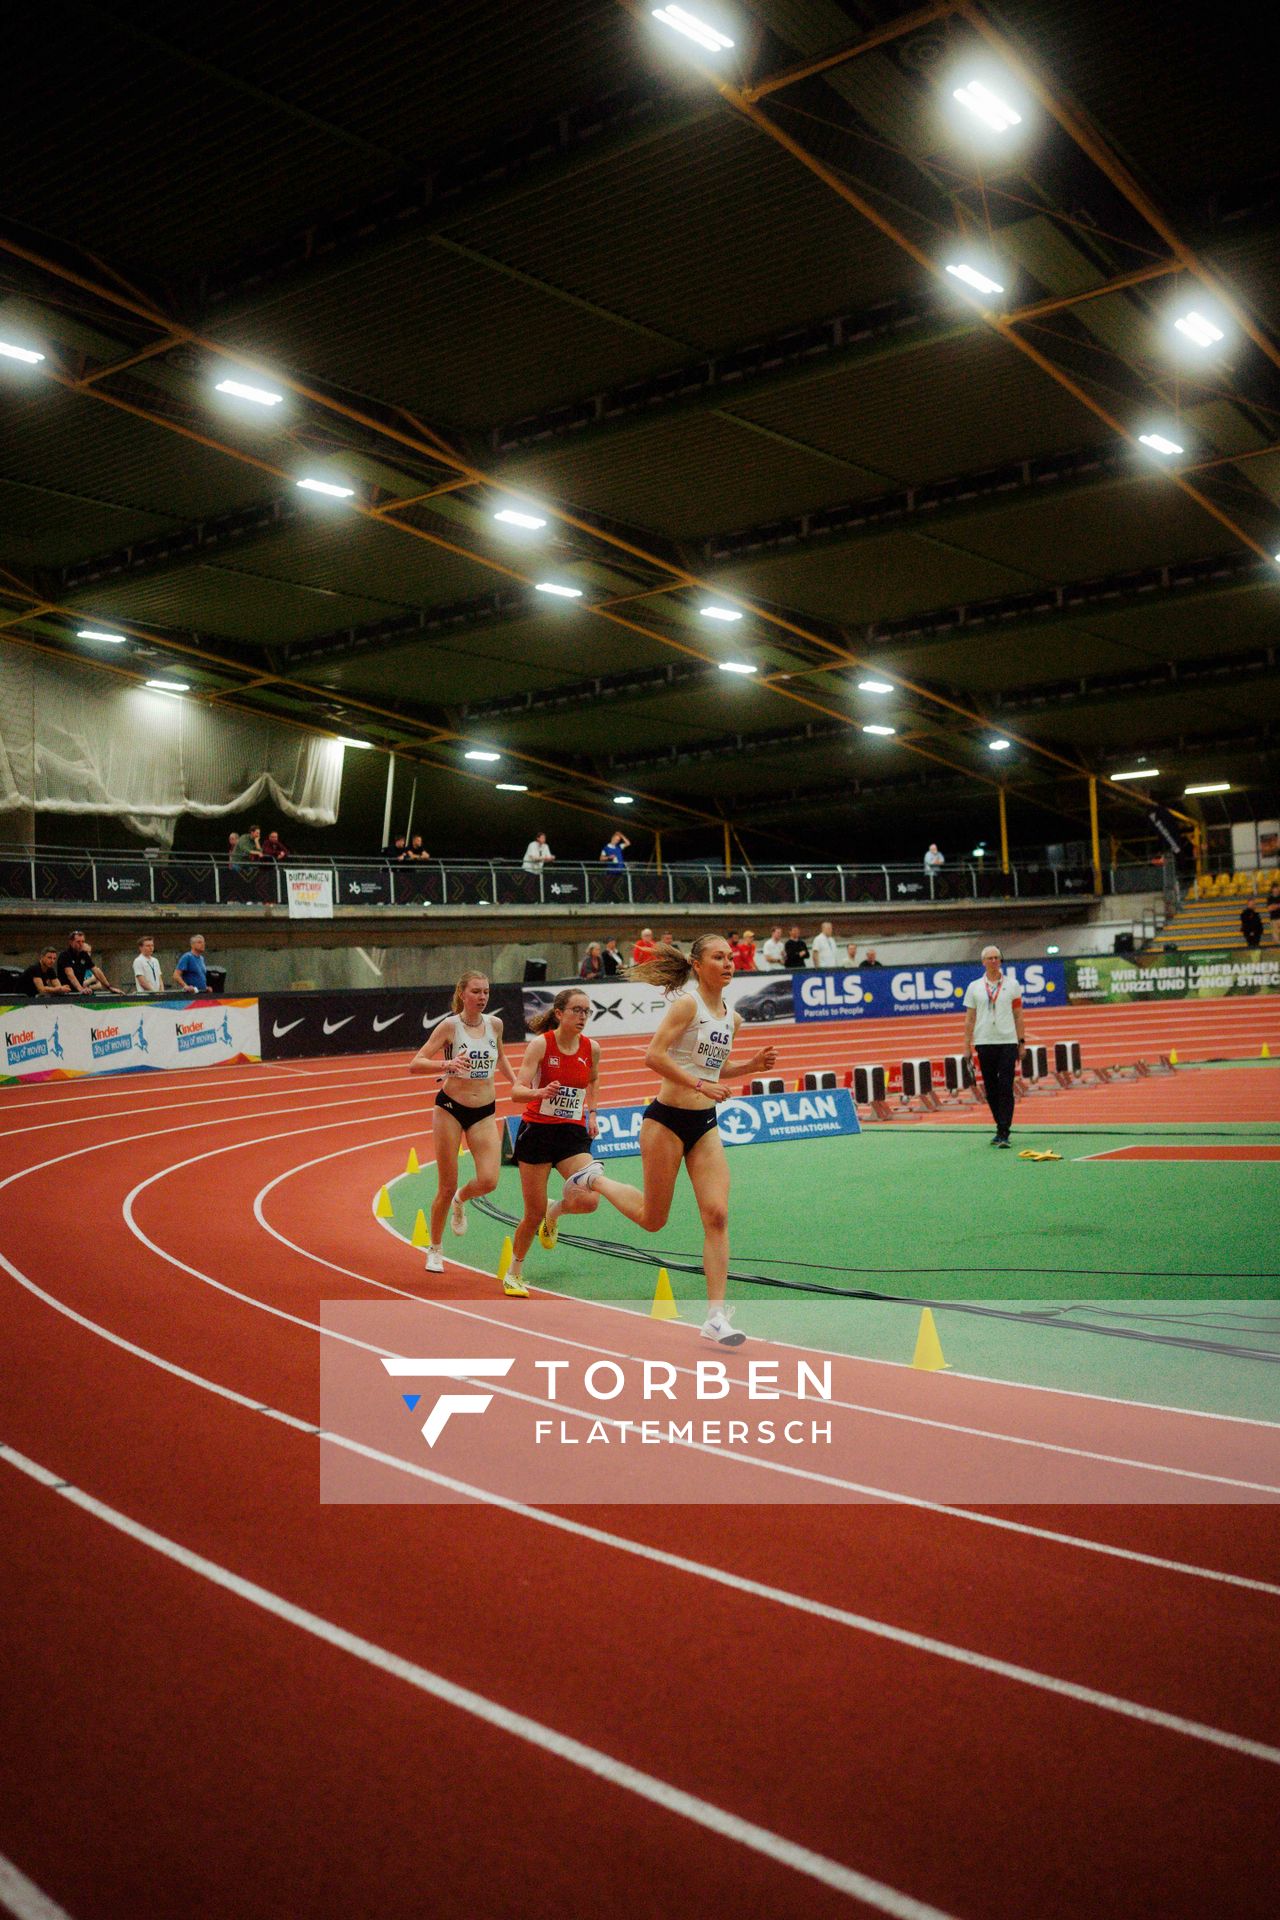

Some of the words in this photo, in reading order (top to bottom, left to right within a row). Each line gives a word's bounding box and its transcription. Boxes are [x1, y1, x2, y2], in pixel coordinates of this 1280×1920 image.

[1110, 969, 1137, 980] WIR
[1139, 966, 1185, 980] HABEN
[1188, 962, 1279, 977] LAUFBAHNEN
[1111, 981, 1154, 993] KURZE
[1157, 979, 1185, 990] UND
[1188, 976, 1233, 989] LANGE
[804, 1008, 829, 1017] Parcels
[830, 1008, 838, 1016] to
[839, 1006, 864, 1016] People
[894, 1003, 920, 1012] Parcels
[930, 1001, 954, 1011] People
[549, 1095, 580, 1109] WEIKE
[761, 1095, 838, 1123] PLAN
[594, 1112, 643, 1140] PLA
[769, 1121, 841, 1136] INTERNATIONAL
